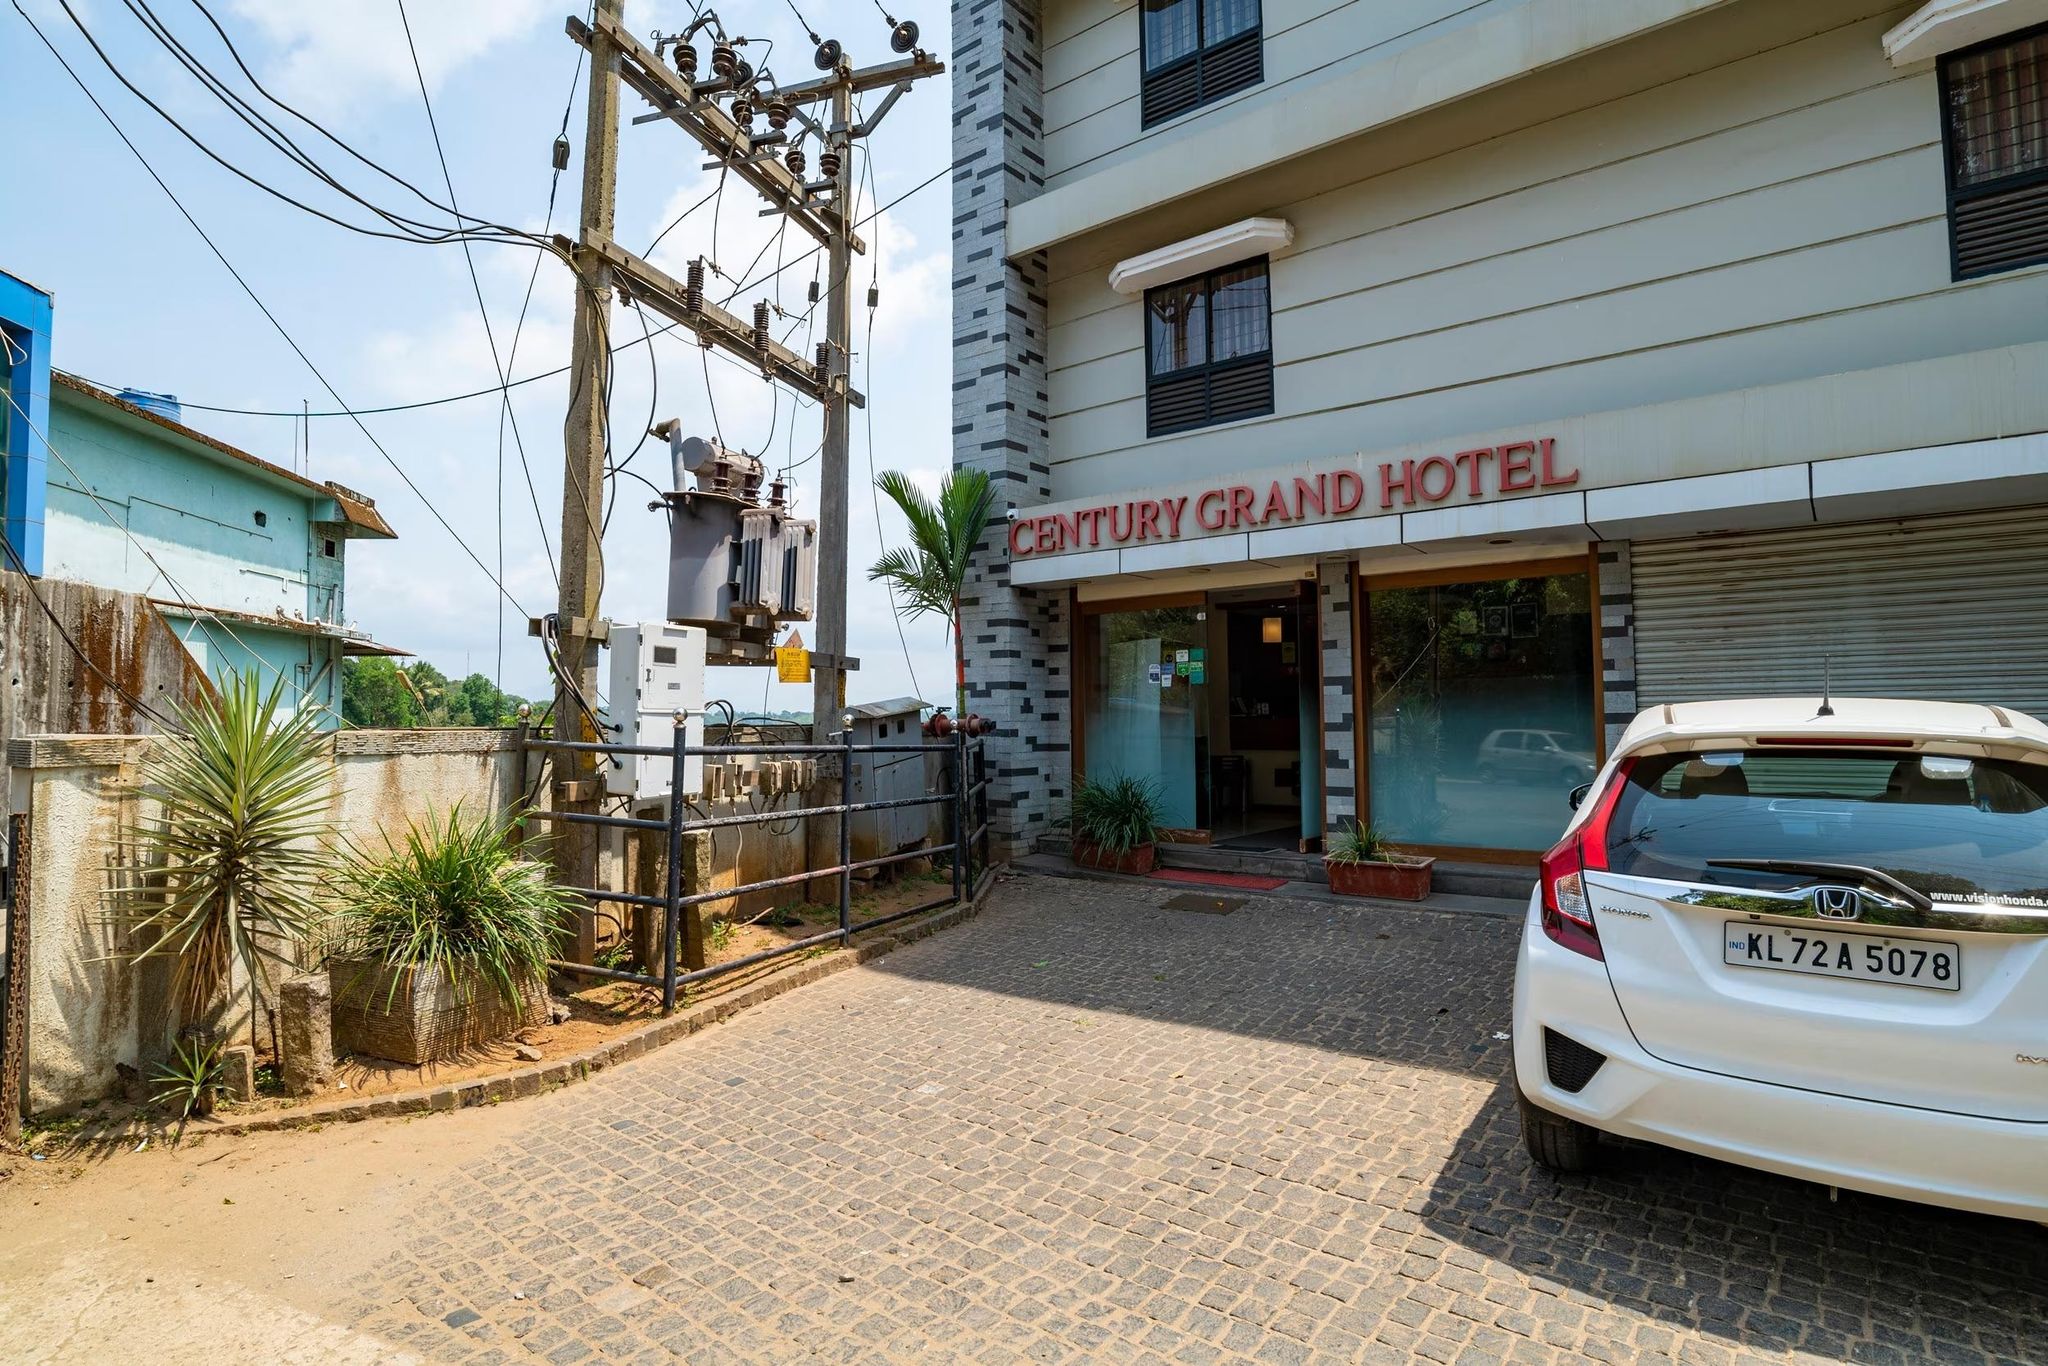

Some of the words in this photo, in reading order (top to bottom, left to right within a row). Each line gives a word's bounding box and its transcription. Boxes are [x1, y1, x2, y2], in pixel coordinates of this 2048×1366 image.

[1010, 496, 1188, 555] CENTURY
[1195, 470, 1364, 530] GRAND
[1377, 438, 1579, 508] HOTEL
[1729, 941, 1745, 950] IND
[1866, 944, 1951, 981] 5078
